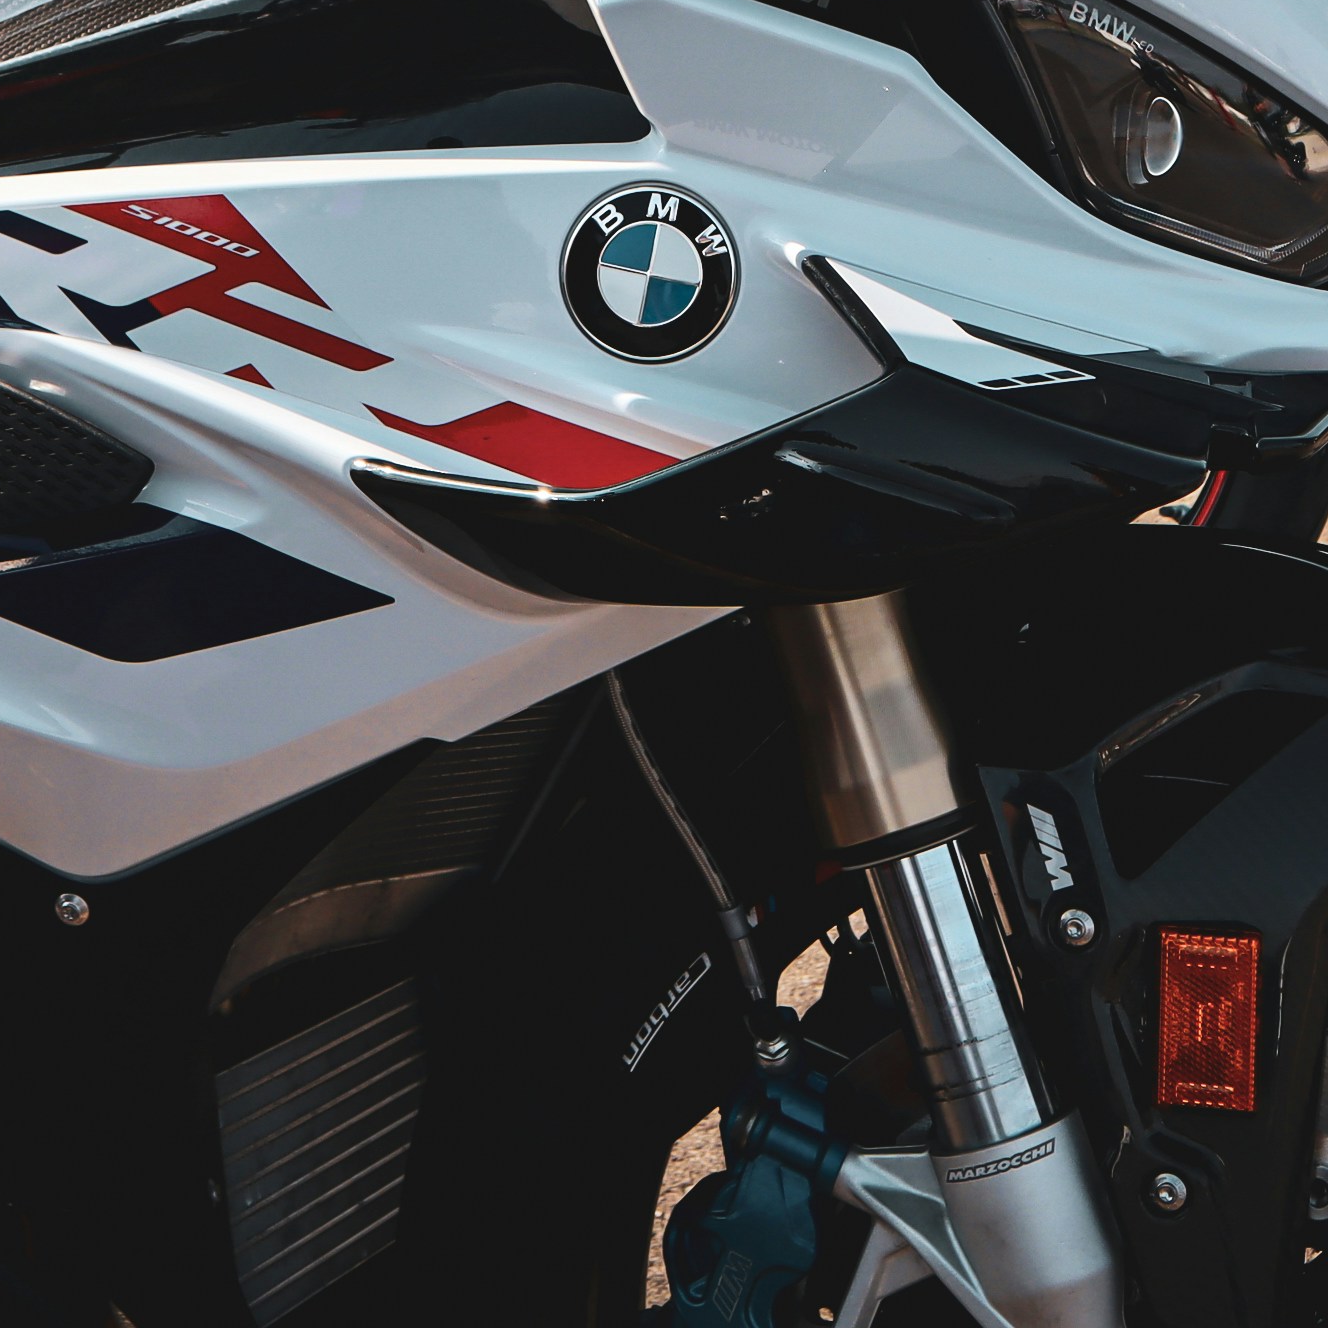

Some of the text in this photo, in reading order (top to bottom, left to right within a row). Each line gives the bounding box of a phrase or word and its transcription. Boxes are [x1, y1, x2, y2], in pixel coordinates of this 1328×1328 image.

[1069, 0, 1137, 43] BMW
[120, 204, 260, 258] S1000
[592, 192, 728, 257] BMW
[948, 1141, 1054, 1181] MARZOCCHI
